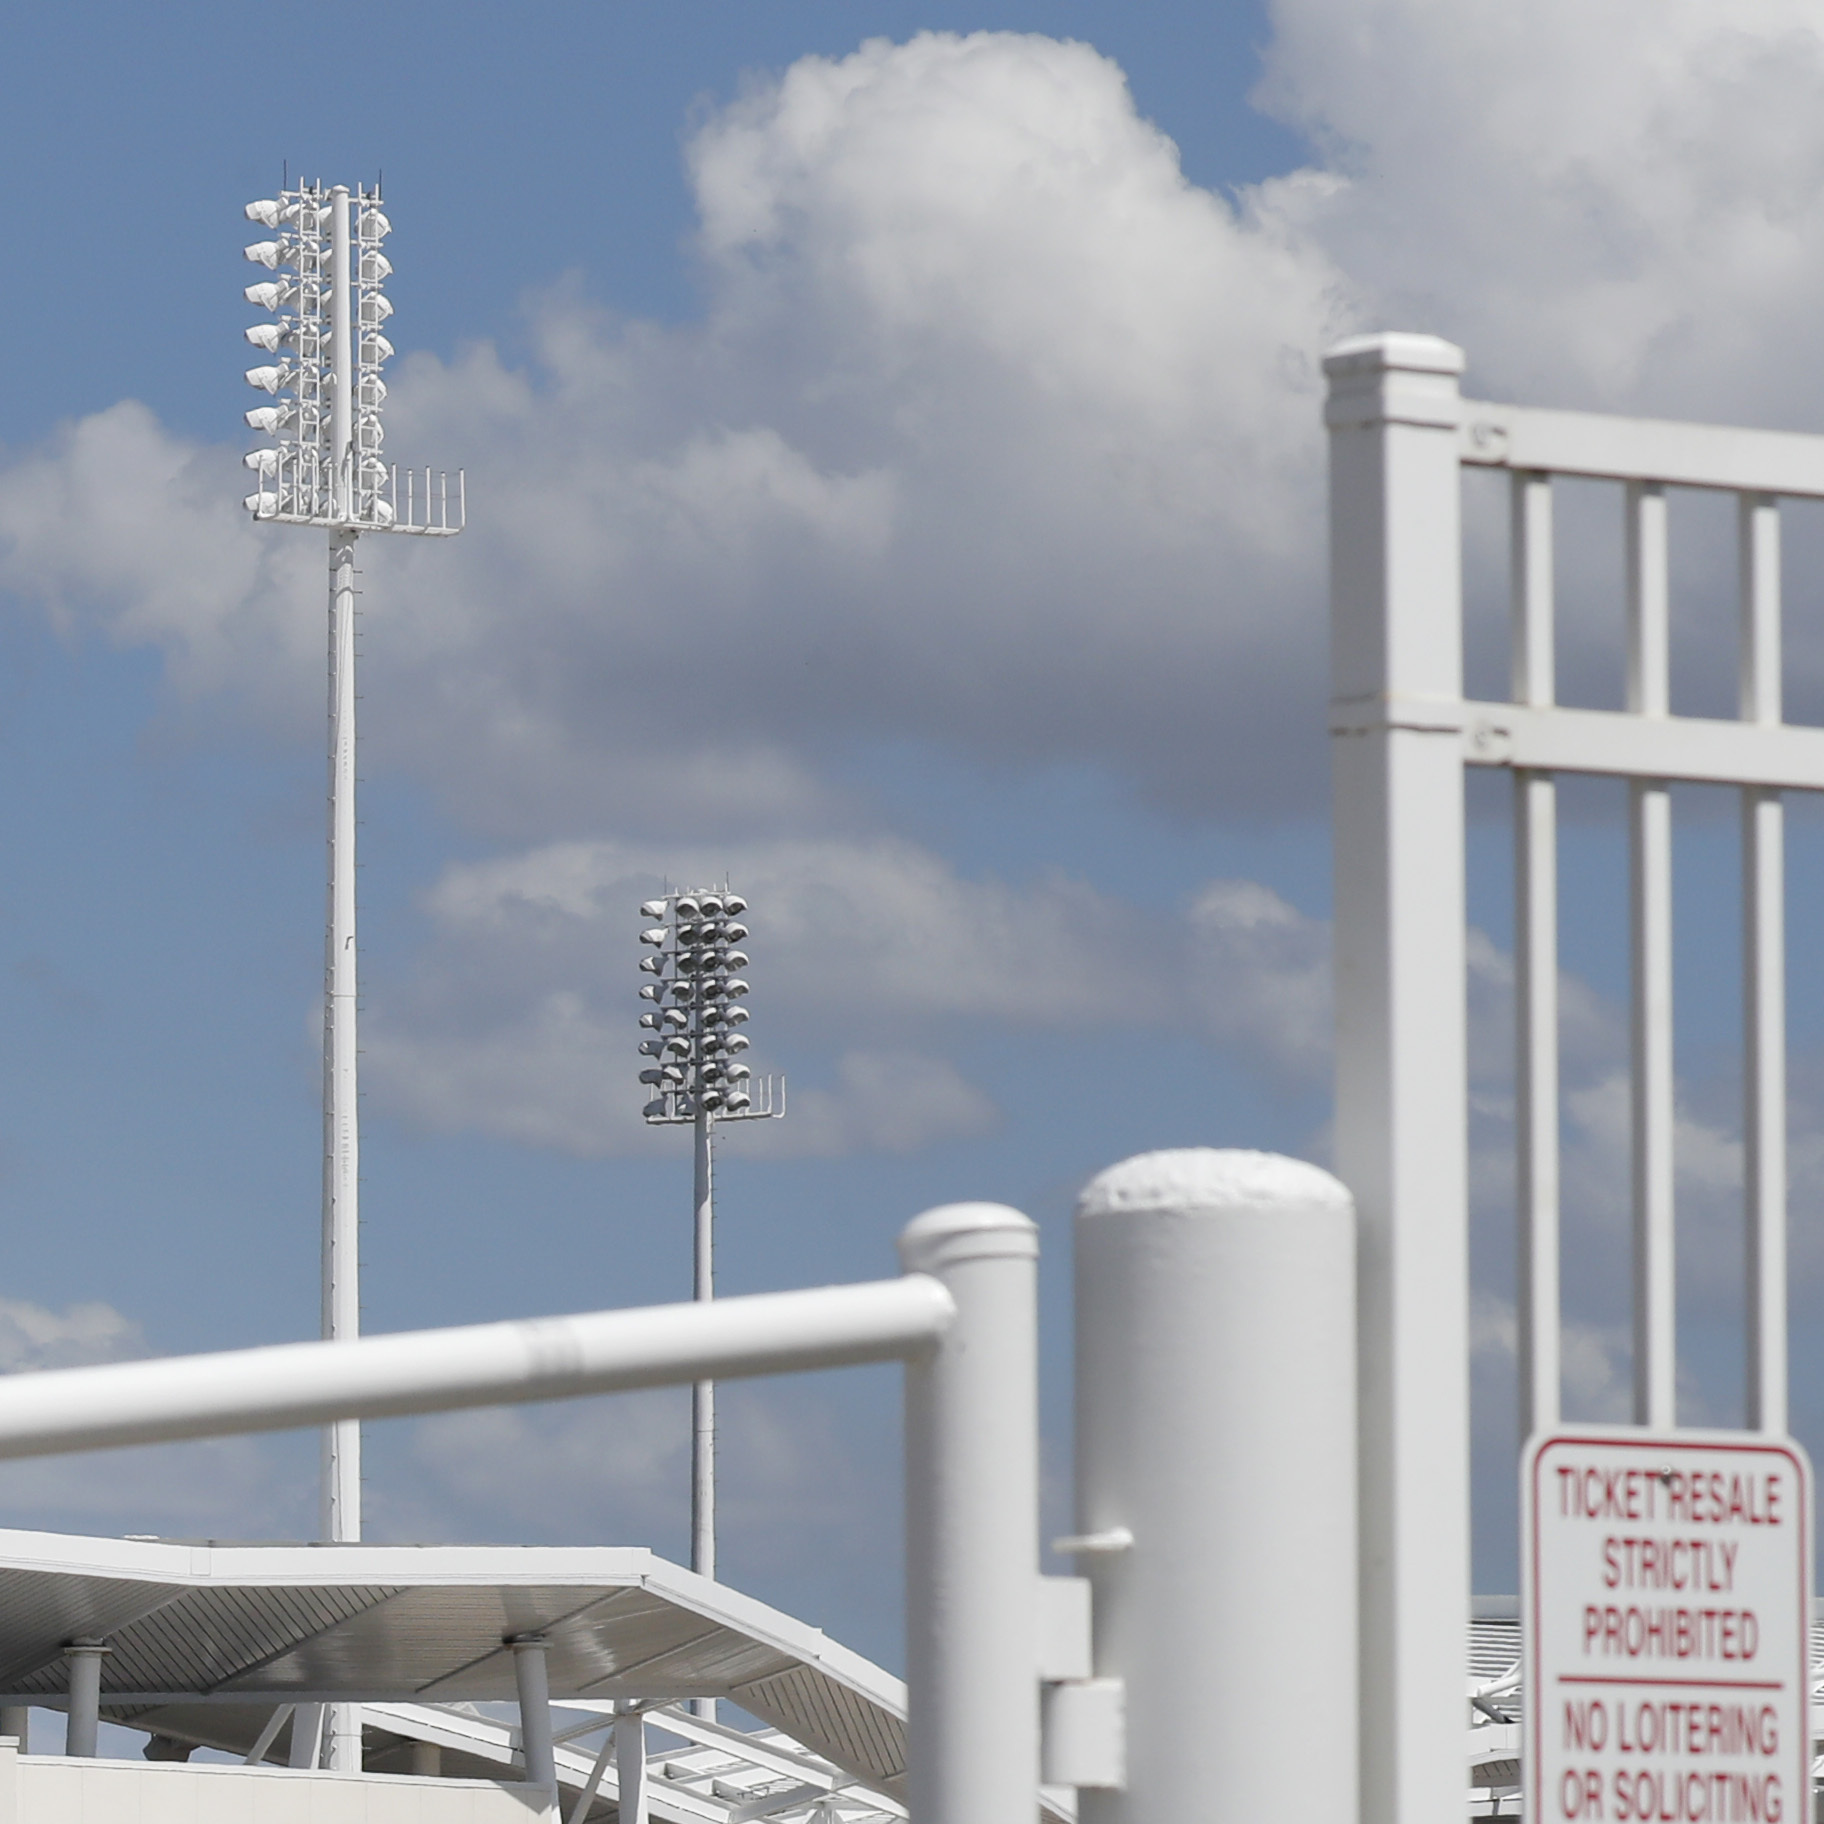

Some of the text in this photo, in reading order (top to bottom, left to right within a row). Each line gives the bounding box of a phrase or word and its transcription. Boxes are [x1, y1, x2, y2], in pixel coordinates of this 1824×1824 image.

[1556, 1465, 1783, 1526] TICKET RESALE
[1601, 1538, 1740, 1592] STRICTLY
[1583, 1606, 1759, 1662] PROHIBITED
[1562, 1700, 1780, 1757] NO LOITERING
[1560, 1768, 1605, 1821] OR
